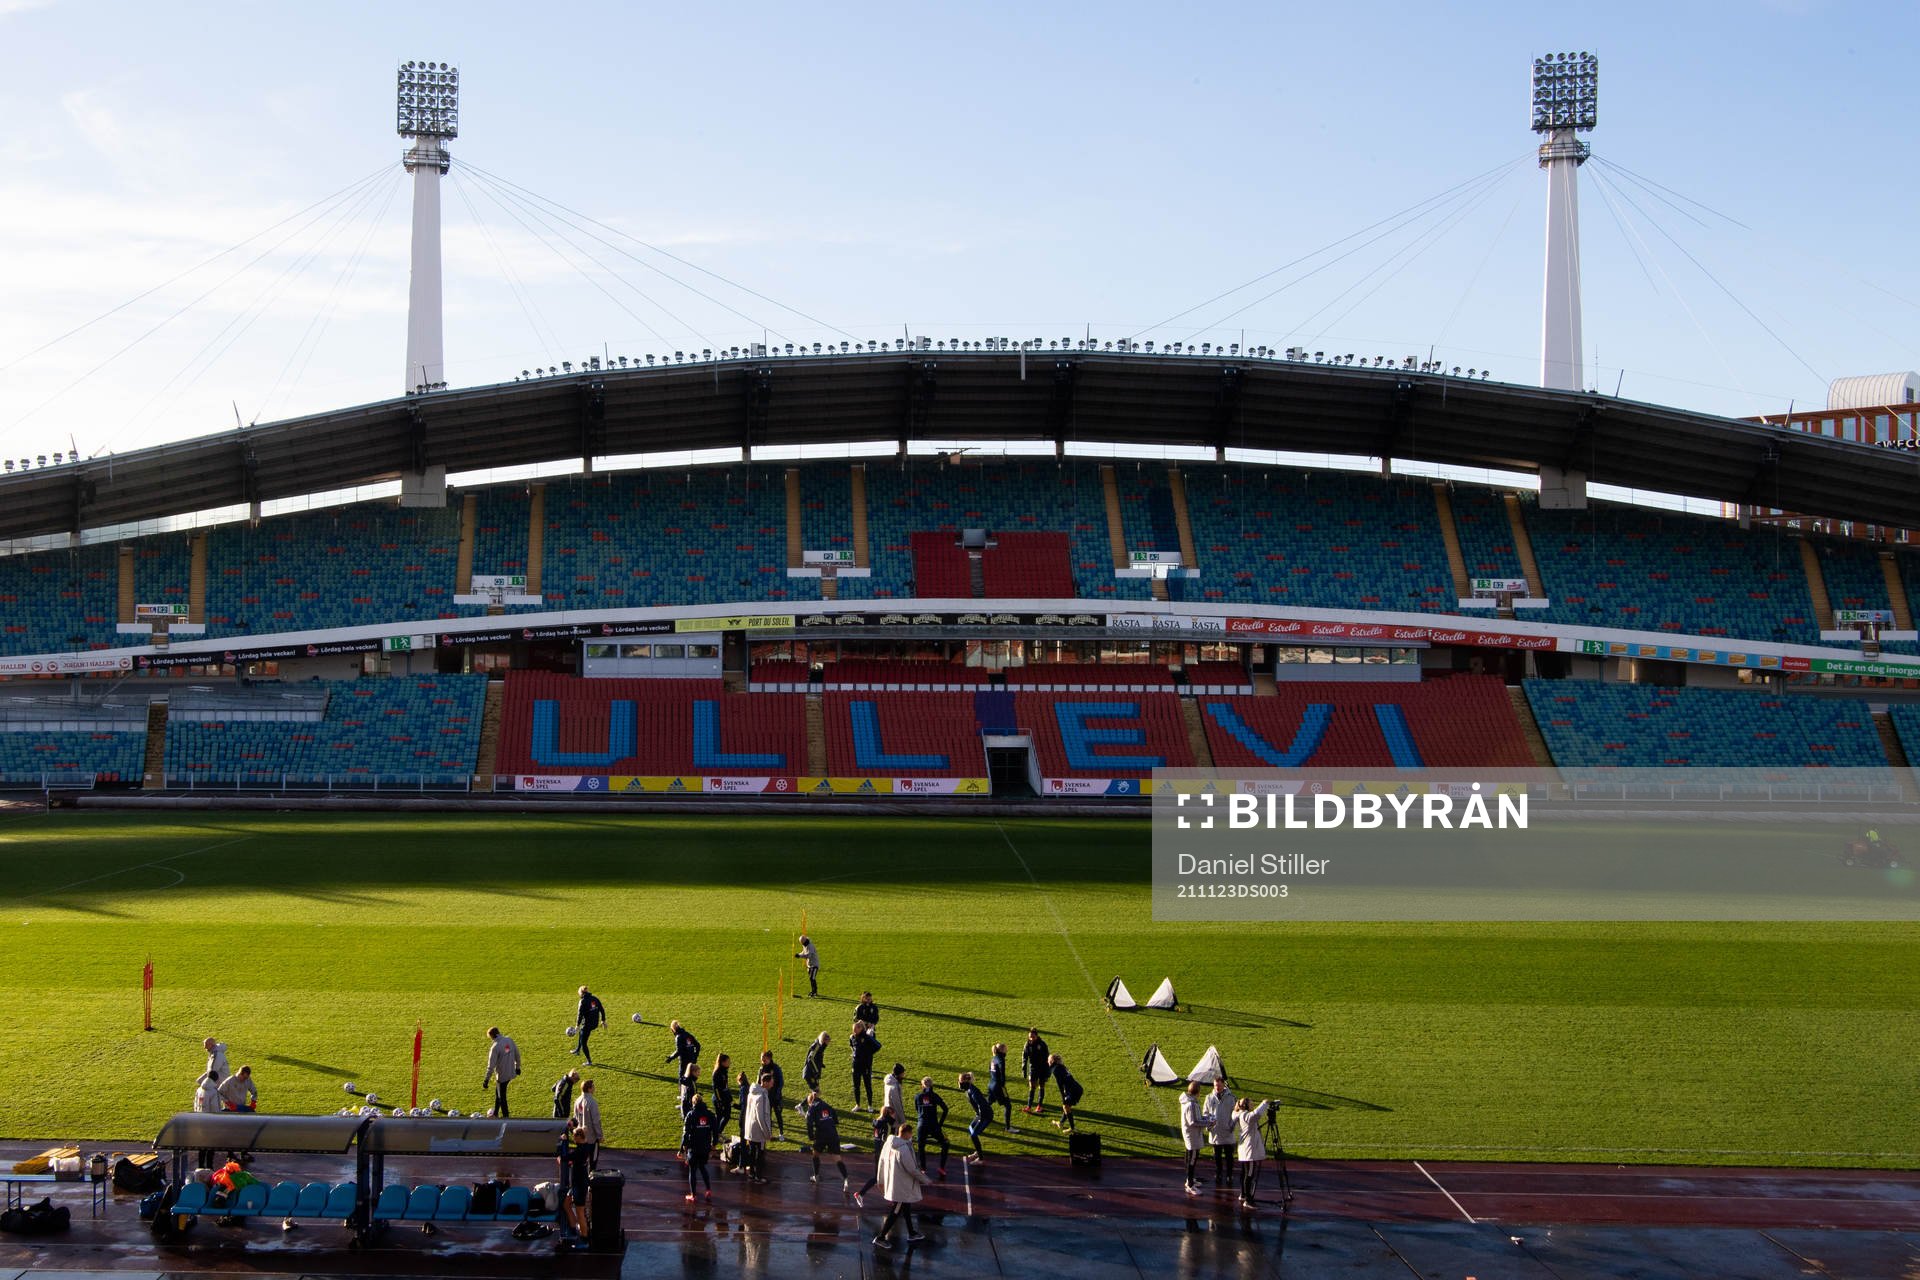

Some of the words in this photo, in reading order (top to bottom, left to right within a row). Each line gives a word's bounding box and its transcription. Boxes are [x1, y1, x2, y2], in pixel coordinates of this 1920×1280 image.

[748, 618, 762, 627] PORT
[763, 618, 771, 626] DU
[772, 617, 790, 625] SOLEIL
[1112, 619, 1141, 628] RASTA
[1152, 620, 1181, 629] RASTA
[1192, 621, 1220, 630] RASTA
[1232, 621, 1264, 631] Estrella
[1268, 622, 1301, 632] Estrella
[536, 630, 556, 638] Lördag
[1312, 624, 1345, 634] Estrella
[1350, 626, 1383, 636] Estrella
[1394, 628, 1427, 638] Estrella
[1432, 630, 1466, 641] Estrella
[1478, 635, 1511, 646] Estrella
[355, 643, 378, 651] veckan!
[1517, 638, 1551, 648] Estrella
[238, 652, 259, 660] Lördag
[1827, 662, 1843, 670] Det
[1844, 663, 1853, 671] är
[1867, 664, 1885, 674] dag
[1886, 665, 1920, 677] imorgo
[531, 700, 1425, 775] ULLEVI
